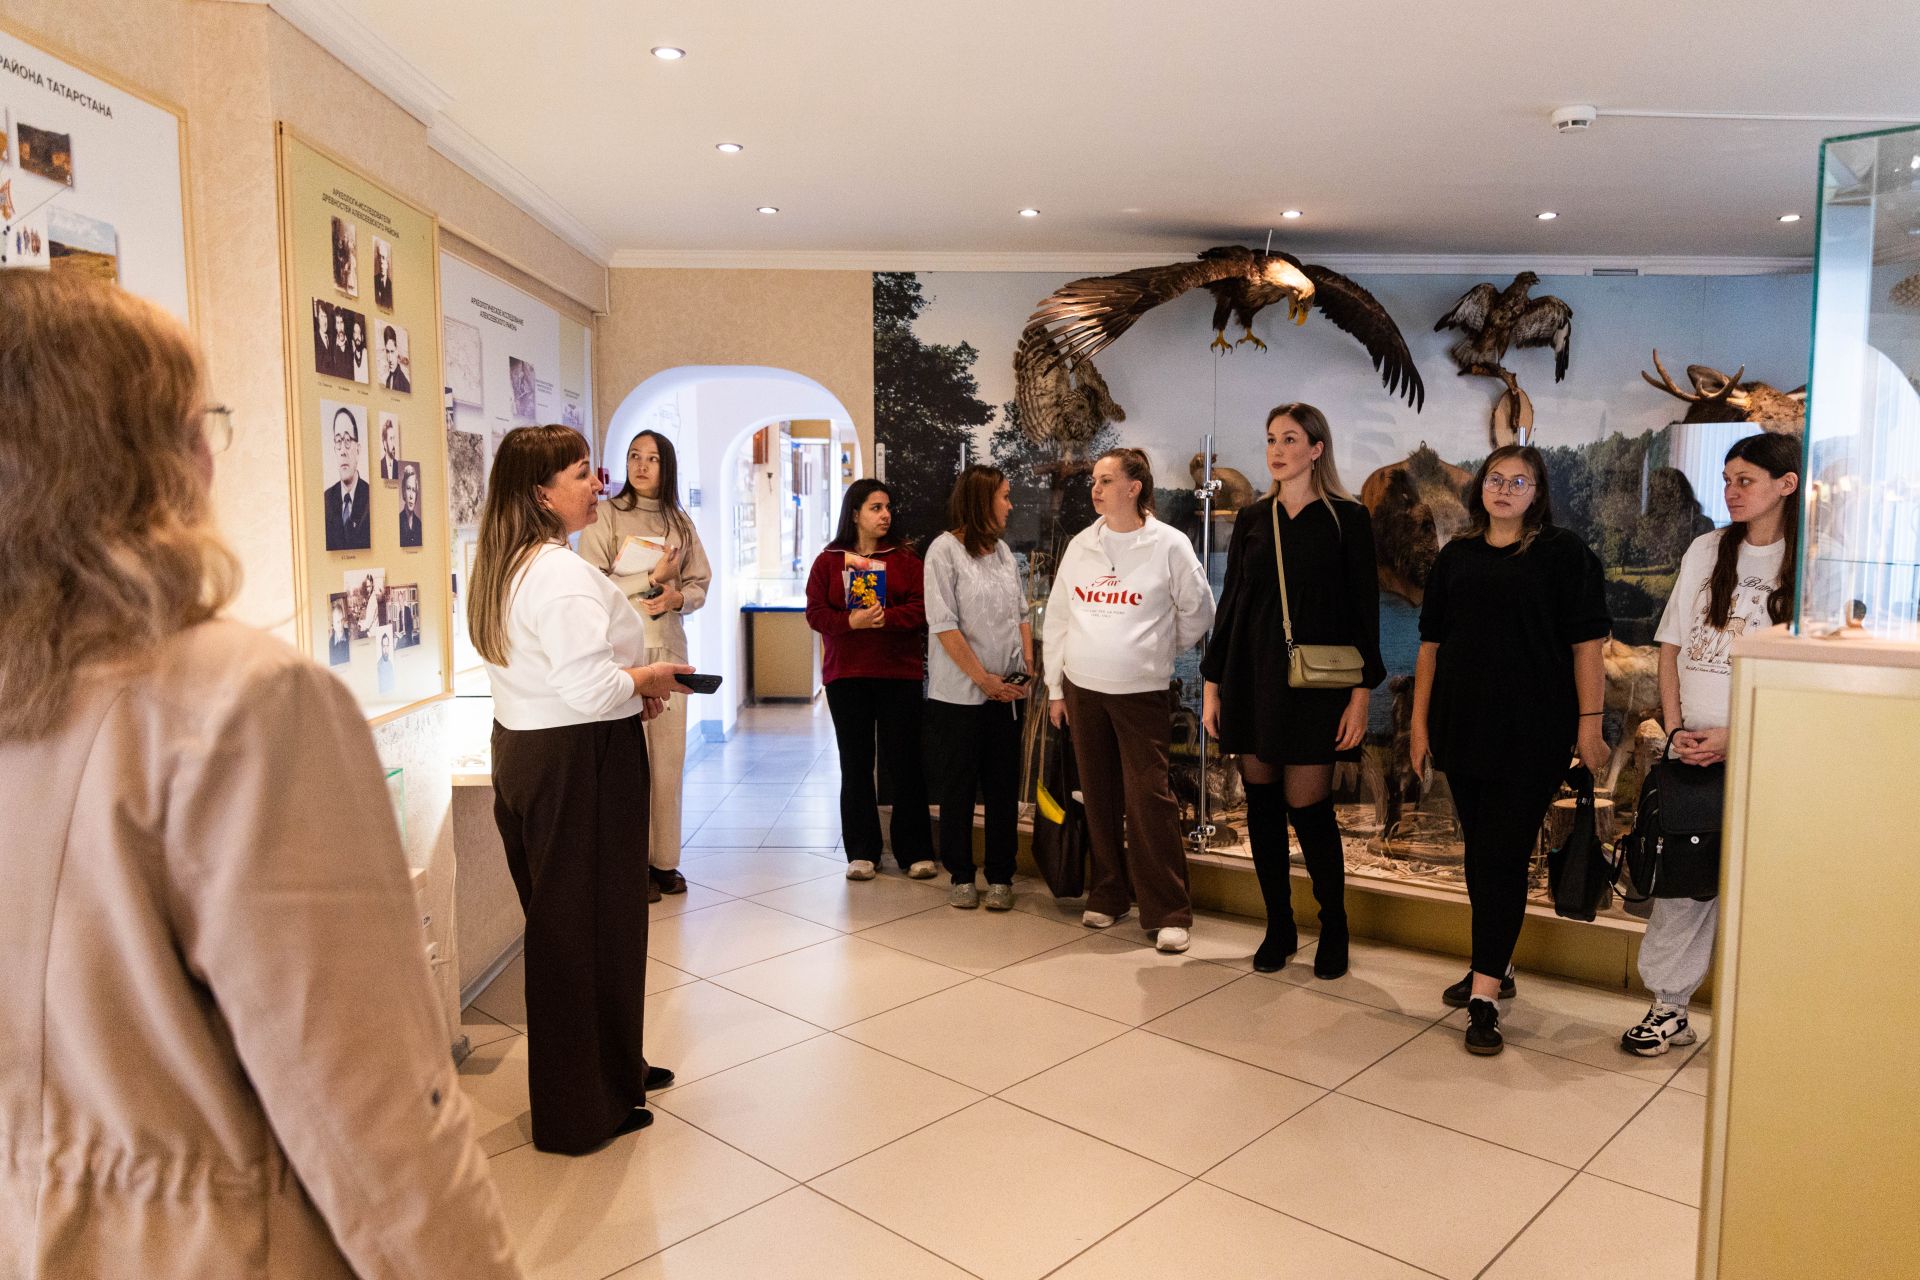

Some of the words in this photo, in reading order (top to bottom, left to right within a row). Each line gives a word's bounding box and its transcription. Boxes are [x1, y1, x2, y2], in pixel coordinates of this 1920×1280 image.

[47, 77, 113, 119] ТАТАРСТАНА
[1091, 575, 1121, 588] Far
[1072, 586, 1143, 607] Niente
